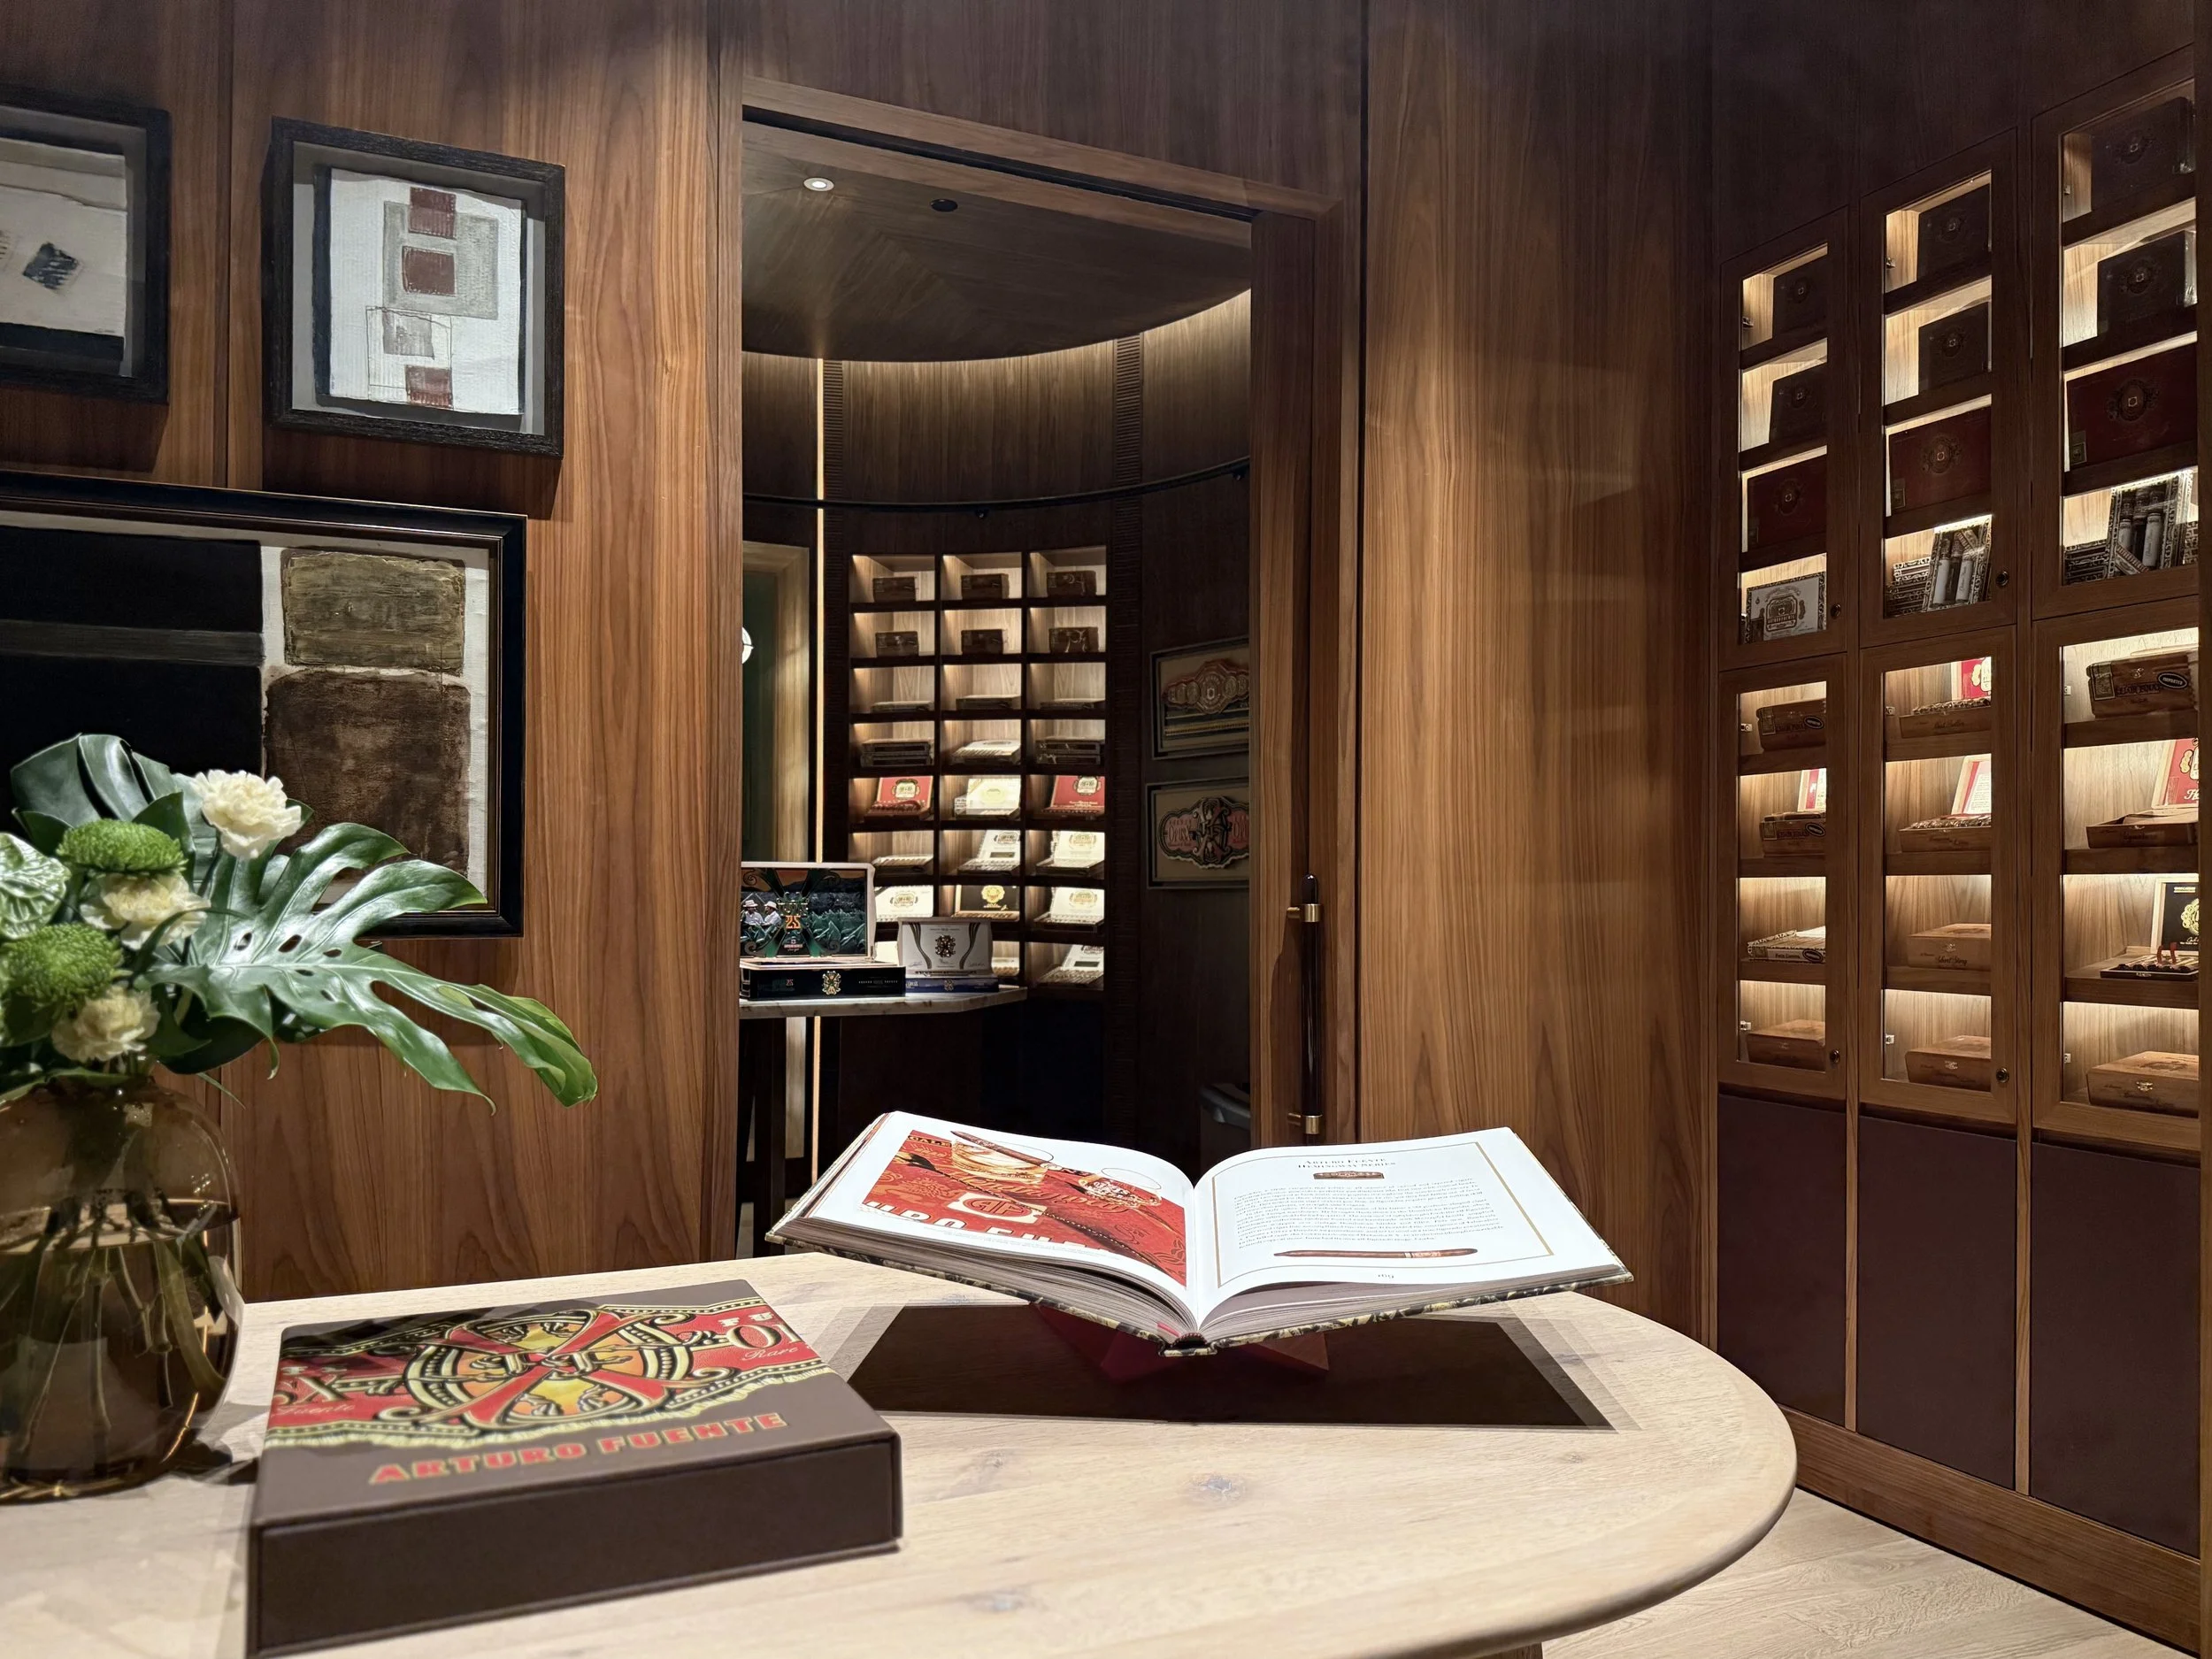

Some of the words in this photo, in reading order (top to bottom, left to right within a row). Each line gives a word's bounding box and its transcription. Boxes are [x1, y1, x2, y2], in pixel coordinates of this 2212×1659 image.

[741, 1347, 800, 1361] Rare
[368, 1442, 588, 1485] ARTURO
[595, 1412, 787, 1454] FUENTE
